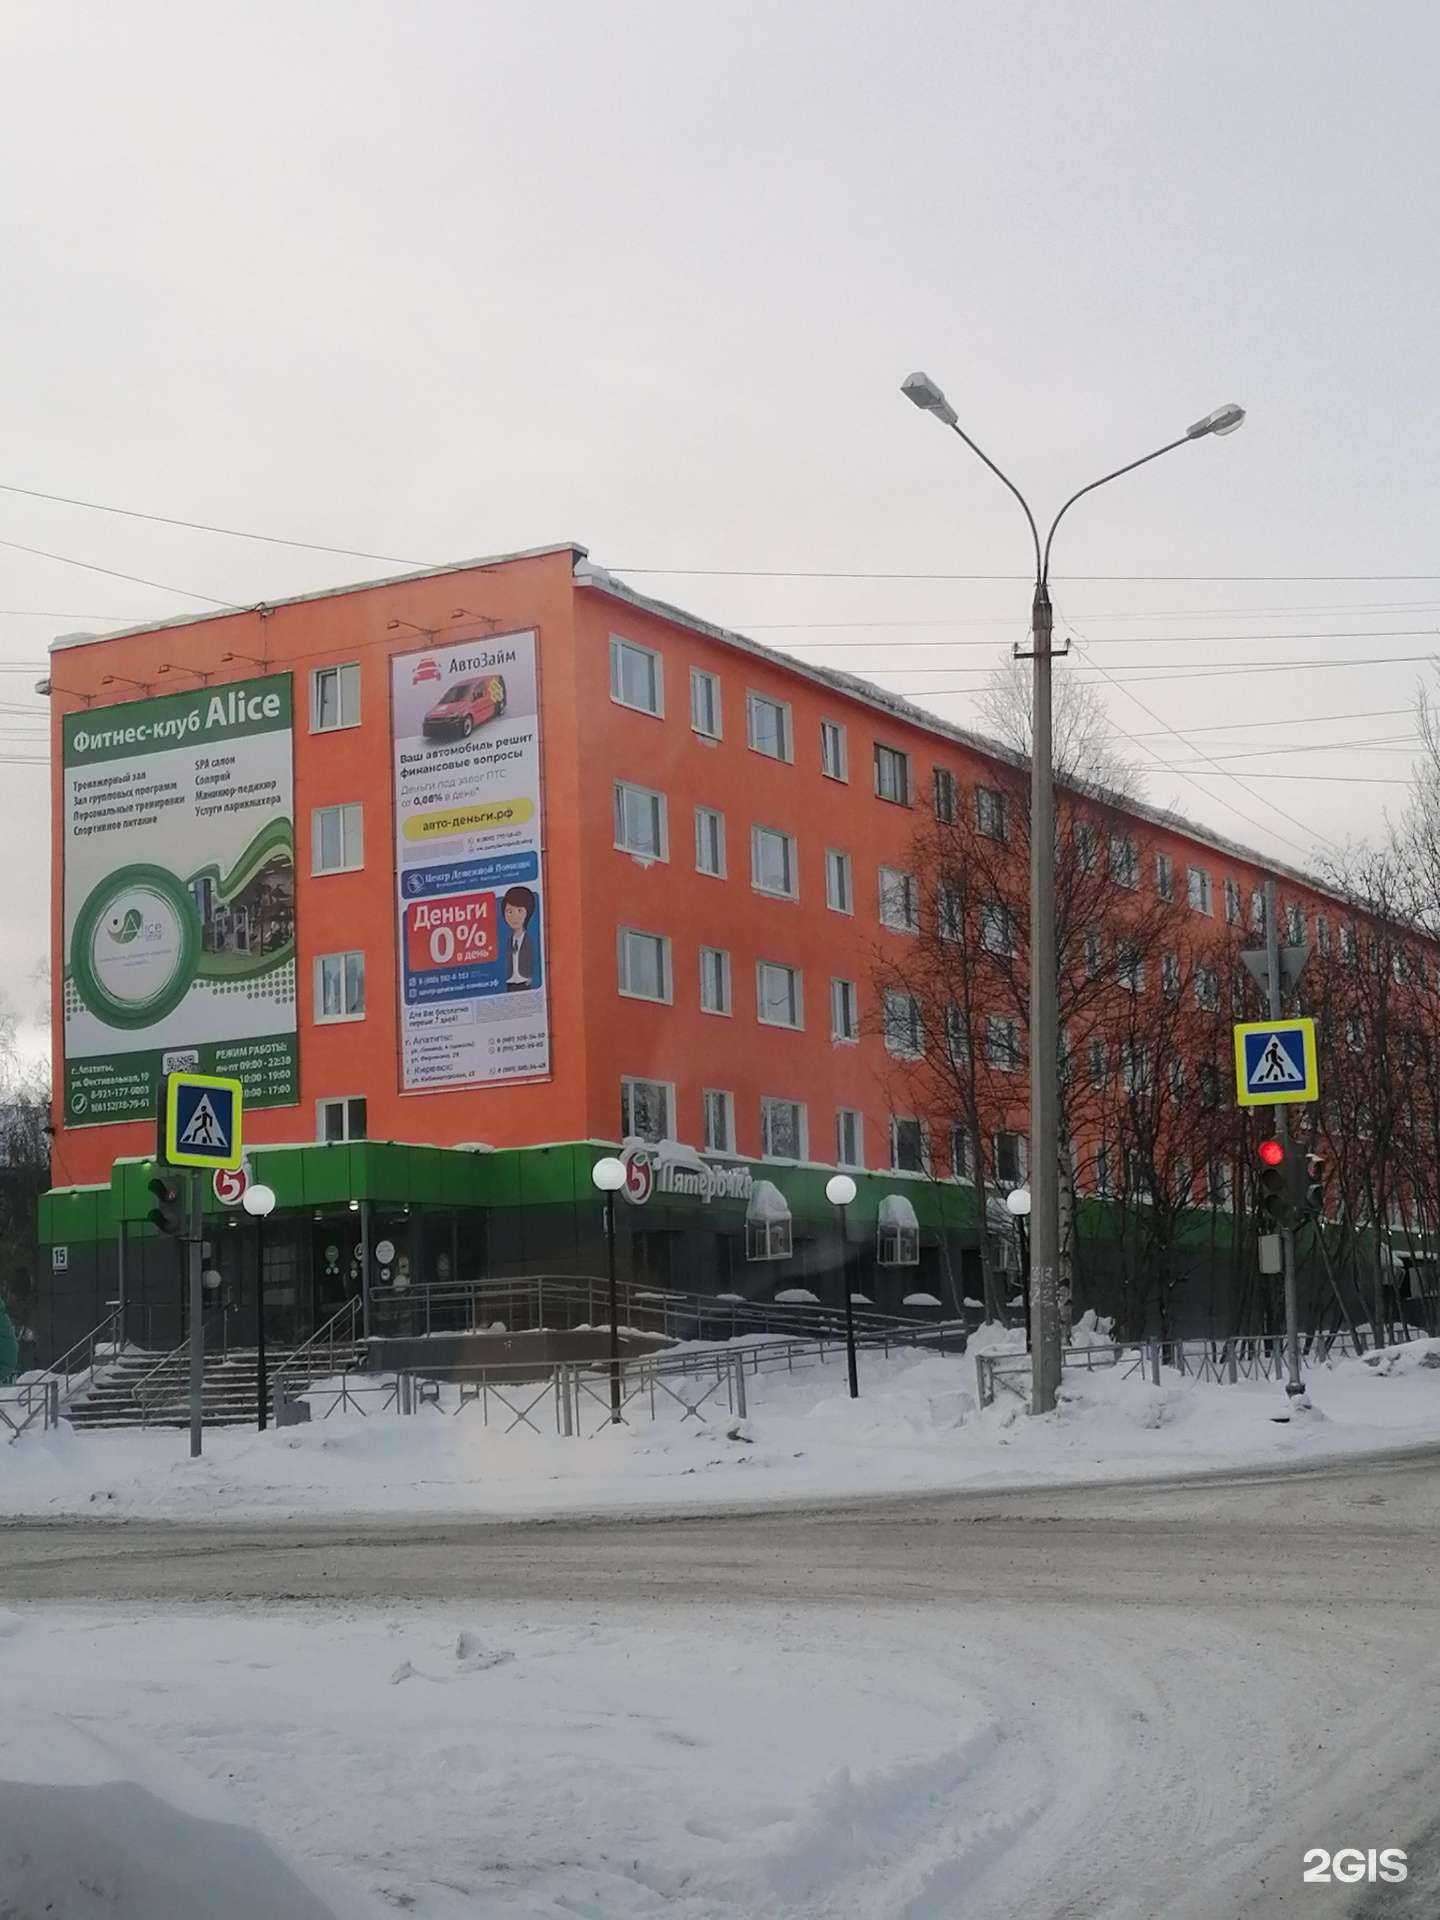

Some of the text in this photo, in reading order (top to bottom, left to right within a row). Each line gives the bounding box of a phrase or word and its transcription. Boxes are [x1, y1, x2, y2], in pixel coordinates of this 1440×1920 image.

[449, 649, 517, 674] АвтоЗайм
[73, 691, 281, 752] Фитнес-клуб Alice
[400, 734, 533, 764] Ваш автомобиль решит
[132, 771, 147, 781] зал
[194, 756, 235, 770] SPA салон
[400, 749, 523, 779] финансовые вопросы
[423, 807, 514, 832] авто-деньги.рф
[414, 901, 488, 932] Деньги
[430, 922, 488, 964] 0%
[55, 1249, 65, 1264] 15
